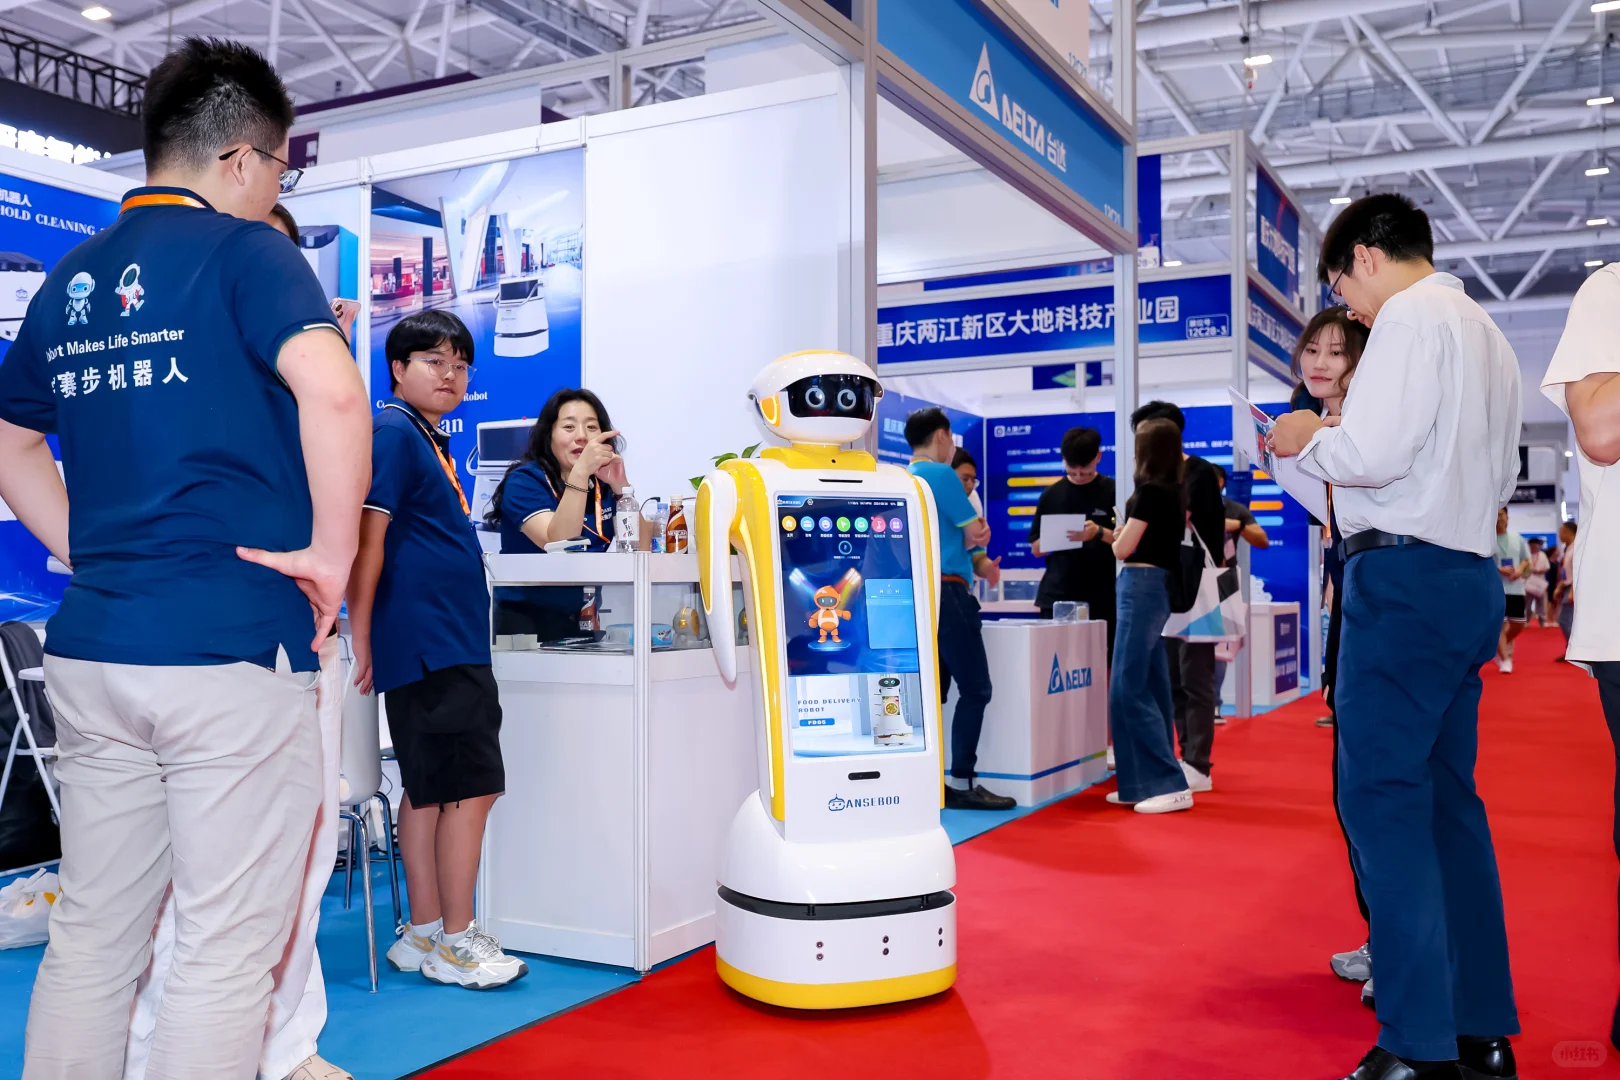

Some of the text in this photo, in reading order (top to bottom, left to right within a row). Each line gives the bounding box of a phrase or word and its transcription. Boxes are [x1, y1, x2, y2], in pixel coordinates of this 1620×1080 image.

[1002, 93, 1044, 156] DELTA
[1047, 132, 1066, 173] 台达
[36, 213, 96, 236] CLEANING
[67, 339, 105, 355] Makes
[108, 333, 129, 349] Life
[131, 328, 185, 345] Smarter
[463, 391, 488, 402] Robot
